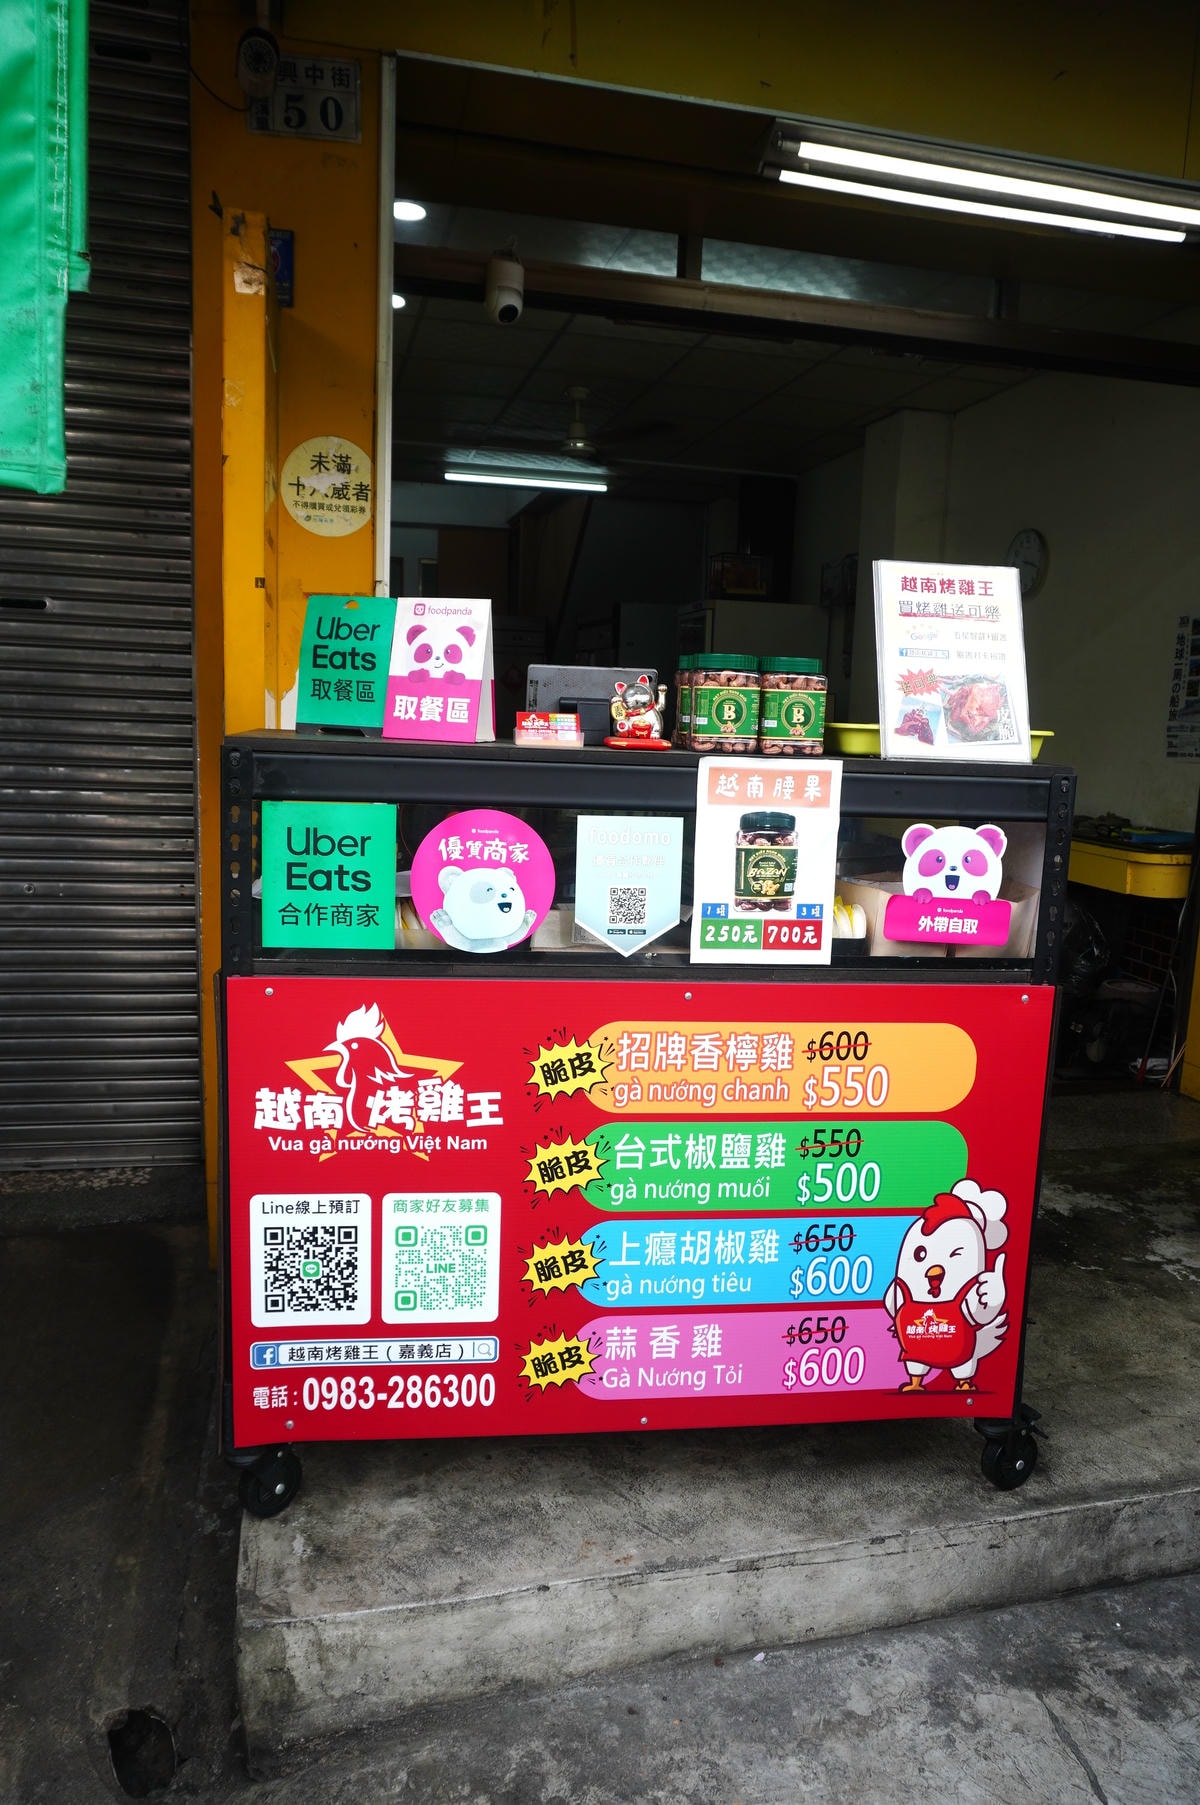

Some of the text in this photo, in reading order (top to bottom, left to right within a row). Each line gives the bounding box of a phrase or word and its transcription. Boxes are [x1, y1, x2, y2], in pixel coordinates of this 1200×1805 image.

[283, 94, 344, 132] 50
[310, 452, 352, 474] 未滿
[901, 576, 994, 597] 越南烤雞王
[427, 606, 472, 616] foodpanda
[898, 600, 1001, 620] 買烤雞送可樂
[315, 616, 380, 641] Uber
[312, 645, 376, 671] Eats
[311, 678, 375, 703] 取餐區
[393, 695, 470, 723] 取餐區
[715, 773, 822, 802] 越南腰果
[286, 826, 372, 857] Uber
[438, 836, 530, 864] 優質商家
[286, 862, 371, 892] Eats
[278, 902, 380, 927] 合作商家
[918, 915, 978, 934] 外帶自取
[705, 924, 757, 943] 250元
[768, 926, 818, 944] 700元
[617, 1033, 794, 1072] 招牌香檸雞
[806, 1030, 869, 1063] $600
[539, 1051, 597, 1088] 脆皮
[614, 1078, 789, 1108] gà nướng chanh
[803, 1065, 889, 1109] $550
[268, 1135, 488, 1155] Vua gà nướng Việt Nam
[614, 1133, 786, 1170] 台式椒鹽雞
[800, 1128, 862, 1160] $550
[537, 1149, 592, 1184] 脆皮
[611, 1176, 770, 1205] gà nướng muối
[797, 1161, 881, 1205] $500
[262, 1200, 360, 1214] Line線上預訂
[393, 1199, 490, 1213] 商家好友募集
[609, 1229, 780, 1266] 上癮胡椒雞
[793, 1223, 854, 1254] $650
[426, 1263, 456, 1273] LINE
[534, 1249, 589, 1283] 脆皮
[791, 1257, 873, 1299] $600
[606, 1271, 751, 1301] gà nướng tiêu
[605, 1324, 722, 1360] 蒜香雞
[786, 1316, 846, 1346] $650
[531, 1346, 584, 1379] 脆皮
[603, 1364, 743, 1390] Gà Nướng Tỏi
[784, 1347, 865, 1389] $600
[302, 1373, 496, 1410] 0983-286300
